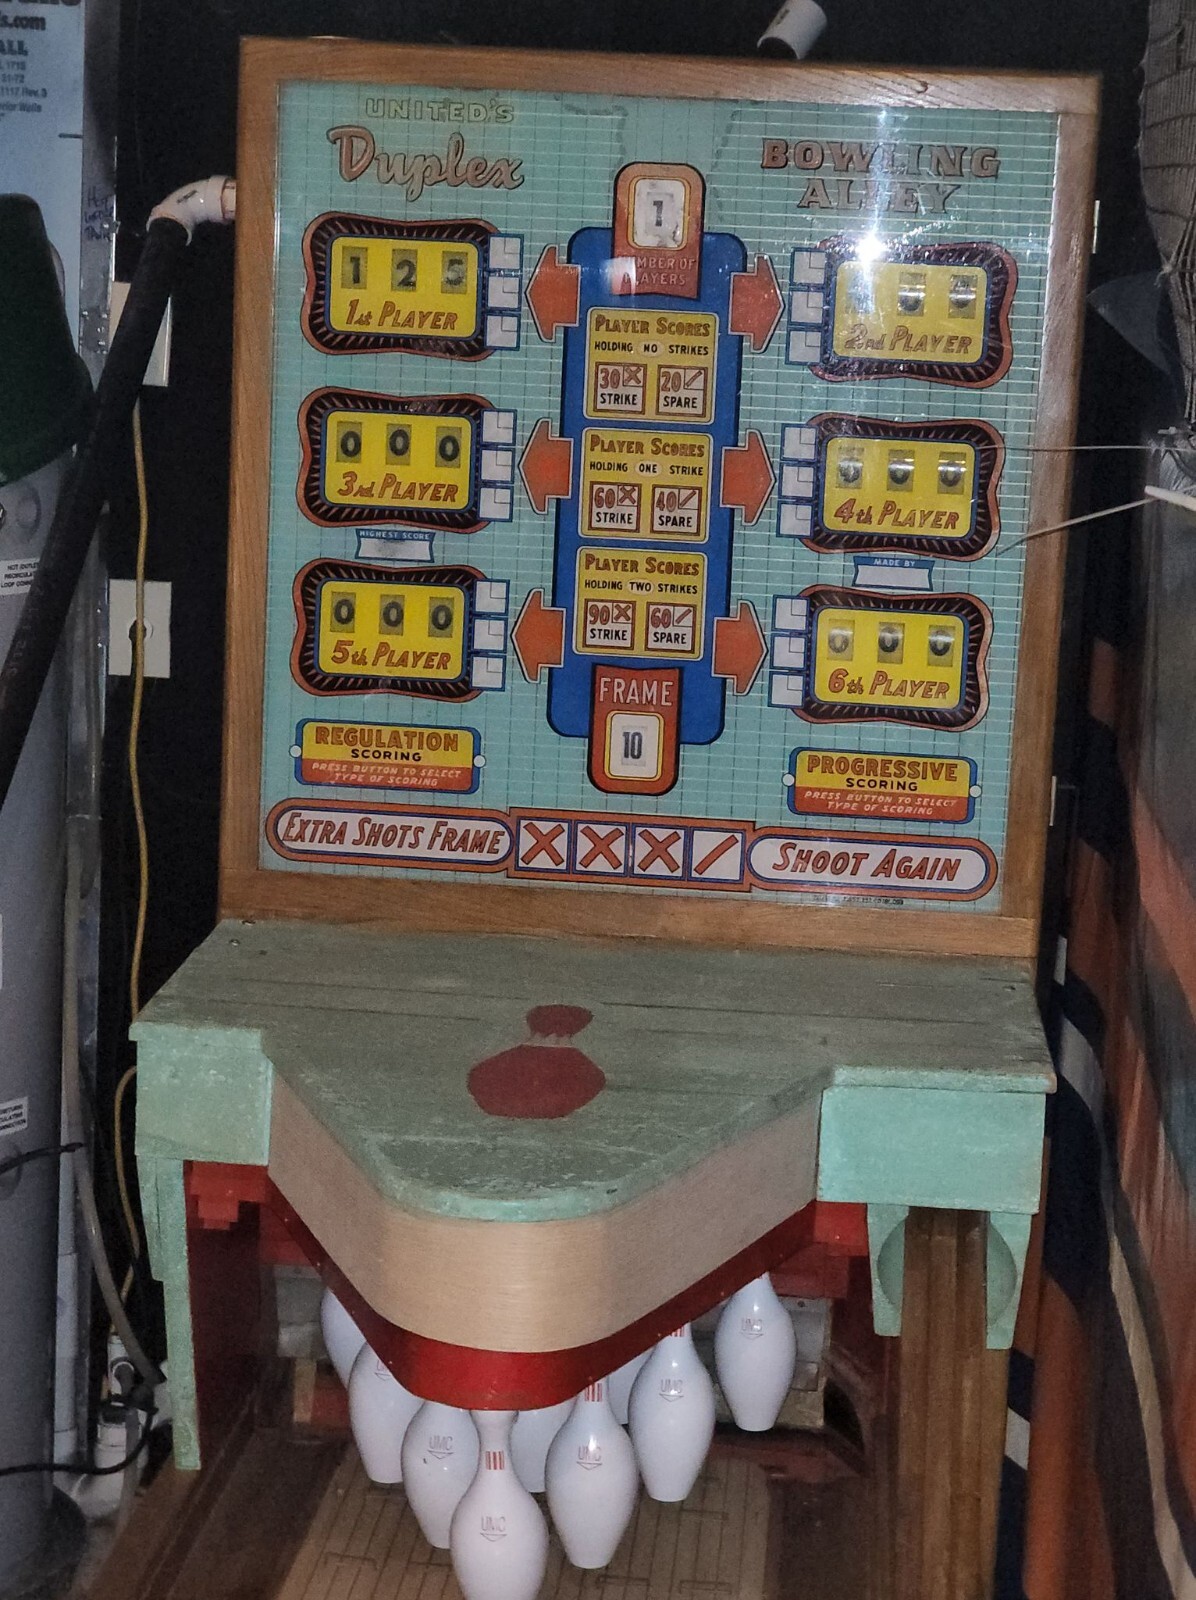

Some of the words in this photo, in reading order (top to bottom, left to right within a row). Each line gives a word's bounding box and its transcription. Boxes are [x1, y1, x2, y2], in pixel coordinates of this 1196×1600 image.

[0, 15, 46, 31] s.com
[366, 98, 514, 123] UNITED'S
[326, 125, 525, 202] Duplex
[761, 138, 1000, 178] BOWLING
[797, 177, 961, 213] ALLEY
[652, 200, 663, 227] 1
[622, 256, 675, 270] MBER
[680, 258, 696, 271] OF
[625, 271, 687, 286] PAYERS
[378, 301, 458, 331] PLAYER
[595, 314, 650, 335] PLAYER
[656, 316, 711, 338] SCORES
[594, 341, 633, 353] HOLDING
[643, 343, 658, 354] NO
[668, 344, 709, 356] STRIKES
[888, 325, 973, 355] PLAYER
[600, 368, 621, 390] 30
[661, 371, 682, 392] 20
[600, 393, 638, 407] STRIKE
[663, 396, 698, 410] SPARE
[590, 434, 645, 455] PLAYER
[651, 437, 705, 459] SCORES
[590, 461, 628, 473] HOLDING
[638, 463, 658, 474] ONE
[669, 464, 704, 476] STRIKE
[378, 473, 459, 503] PLAYER
[594, 486, 616, 510] 60
[656, 490, 677, 513] 40
[595, 511, 634, 525] STRIKE
[658, 514, 693, 528] SPARE
[877, 500, 960, 530] PLAYER
[359, 530, 400, 540] HIGHEST
[402, 532, 431, 541] SCORE
[584, 553, 640, 574] PLAYER
[645, 556, 700, 577] SCORES
[873, 558, 900, 567] MADE
[904, 560, 916, 568] BY
[584, 579, 623, 591] HOLDING
[629, 581, 652, 592] TWO
[657, 583, 698, 595] STRIKES
[588, 603, 610, 626] 90
[650, 606, 671, 629] 60
[589, 627, 628, 641] STRIKE
[653, 630, 687, 645] SPARE
[371, 641, 452, 670] PLAYER
[600, 676, 674, 707] FRAME
[868, 670, 950, 700] PLAYER
[315, 725, 459, 752] REGULATION
[622, 731, 643, 760] 10
[351, 748, 422, 762] SCORING
[311, 762, 347, 772] PRESS
[352, 763, 398, 775] BUTTON
[402, 767, 417, 776] TO
[421, 768, 462, 779] SELECT
[334, 772, 364, 783] TYPE
[370, 774, 383, 784] OF
[387, 776, 439, 787] SCORING
[807, 754, 958, 782] PROGRESSIVE
[845, 777, 919, 792] SCORING
[804, 790, 841, 801] PRESS
[846, 792, 893, 805] BUTTON
[898, 795, 912, 806] TO
[915, 797, 958, 808] SELECT
[827, 801, 858, 812] TYPE
[863, 803, 878, 813] OF
[882, 804, 934, 816] SCORING
[282, 812, 348, 845] EXTRA
[351, 817, 425, 849] SHOTS
[427, 820, 506, 855] FRAME
[772, 842, 870, 877] SHOOT
[871, 848, 962, 882] AGAIN
[429, 1435, 454, 1450] UMC
[481, 1515, 506, 1532] UMC
